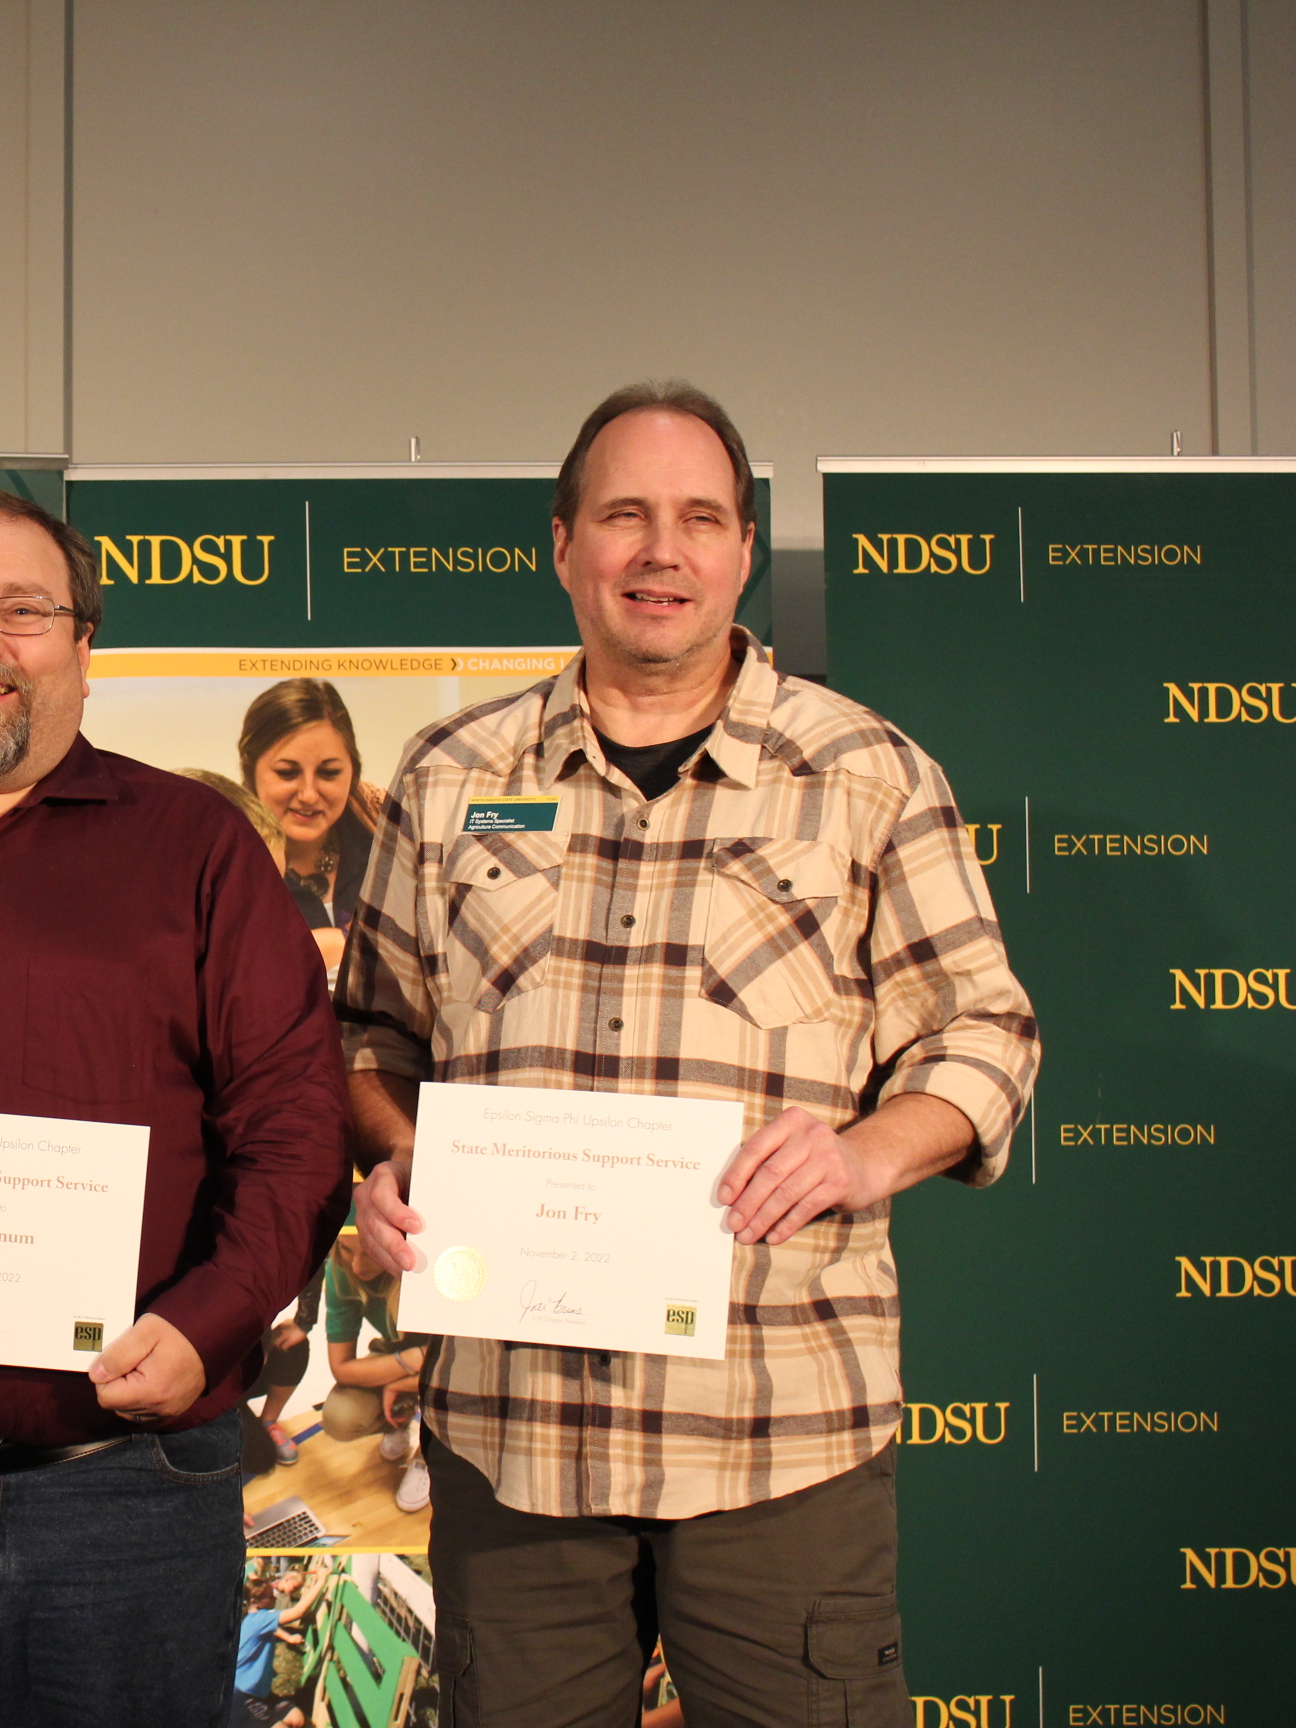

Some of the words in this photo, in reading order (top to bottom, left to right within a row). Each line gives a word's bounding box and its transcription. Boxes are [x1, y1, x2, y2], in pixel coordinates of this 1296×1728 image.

[93, 534, 275, 586] NDSU
[342, 547, 537, 573] EXTENSION
[852, 533, 995, 575] NDSU
[1048, 544, 1202, 565] EXTENSION
[238, 658, 333, 671] EXTENDING
[338, 658, 444, 671] KNOWLEDGE
[467, 657, 556, 671] CHANGING
[1163, 682, 1296, 724] NDSU
[470, 811, 485, 819] Jon
[486, 811, 499, 819] Fry
[1054, 834, 1208, 855] EXTENSION
[483, 1107, 521, 1122] Epsilon
[525, 1110, 560, 1126] Sigma
[563, 1112, 579, 1124] Phi
[582, 1114, 624, 1129] Upsilon
[627, 1117, 673, 1133] Chapter
[1060, 1124, 1216, 1146] EXTENSION
[37, 1139, 82, 1156] Chapter
[451, 1139, 488, 1155] State
[490, 1142, 578, 1161] Meritorious
[582, 1148, 643, 1169] Support
[645, 1152, 701, 1170] Service
[55, 1175, 109, 1193] Service
[546, 1178, 585, 1190] Presented
[588, 1183, 596, 1191] to
[0, 1204, 7, 1212] to
[535, 1203, 567, 1219] Jon
[573, 1205, 602, 1225] Fry
[519, 1247, 568, 1260] November
[571, 1250, 580, 1262] 2,
[584, 1252, 611, 1264] 2022
[666, 1308, 695, 1334] esp
[1062, 1411, 1219, 1433] EXTENSION
[909, 1694, 1016, 1728] DSU
[1068, 1704, 1226, 1726] EXTENSION
